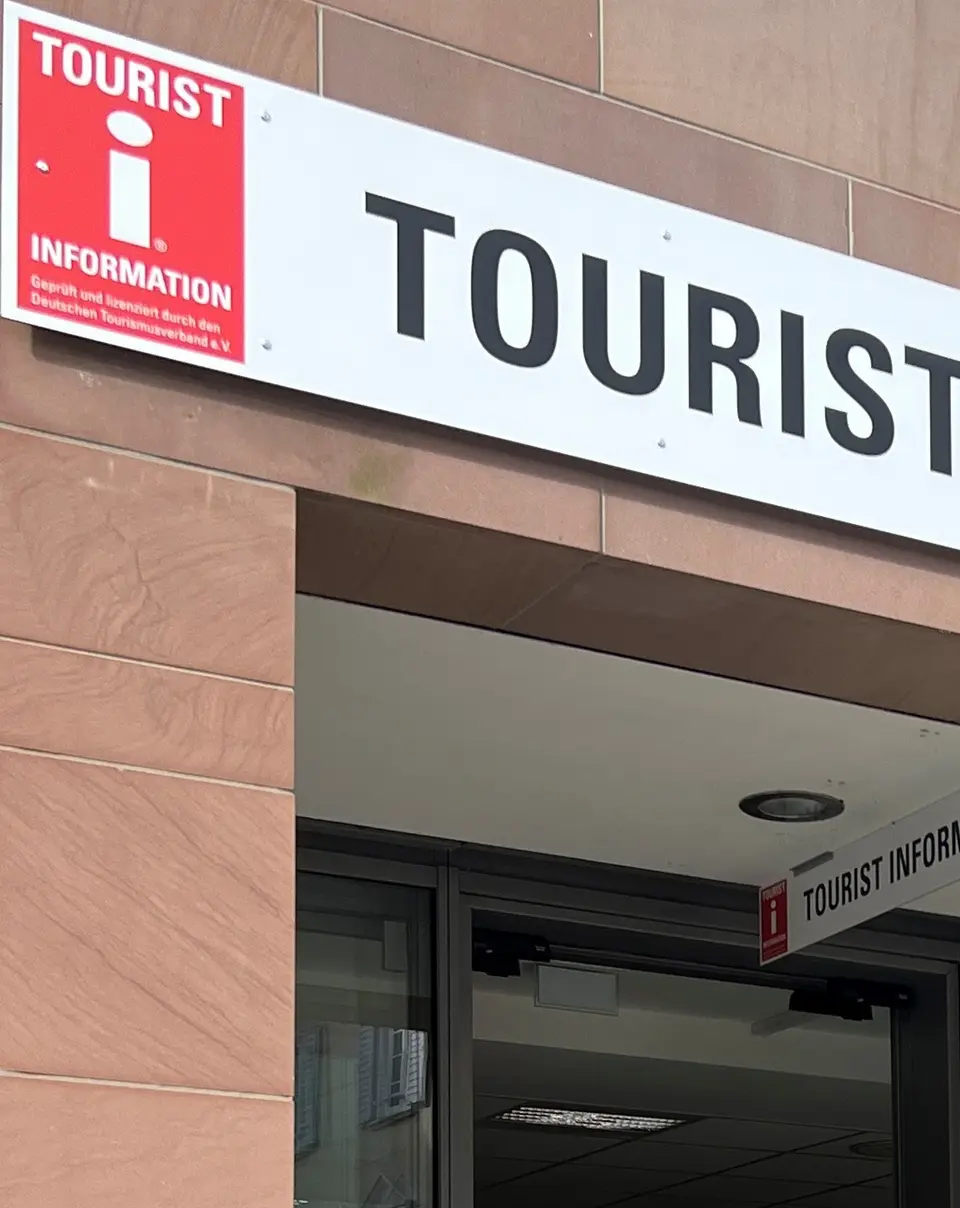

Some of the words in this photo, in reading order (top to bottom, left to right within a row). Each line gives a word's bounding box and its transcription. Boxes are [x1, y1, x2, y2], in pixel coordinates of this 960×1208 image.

[32, 31, 232, 128] TOURIST
[30, 274, 78, 300] Geprüft
[80, 288, 103, 305] und
[105, 293, 160, 320] lizenziert
[161, 308, 196, 327] durch
[197, 317, 221, 335] den
[31, 233, 232, 311] INFORMATION
[30, 292, 98, 321] Deutschen
[101, 308, 209, 348] Tourismusverband
[803, 855, 883, 921] TOURIST
